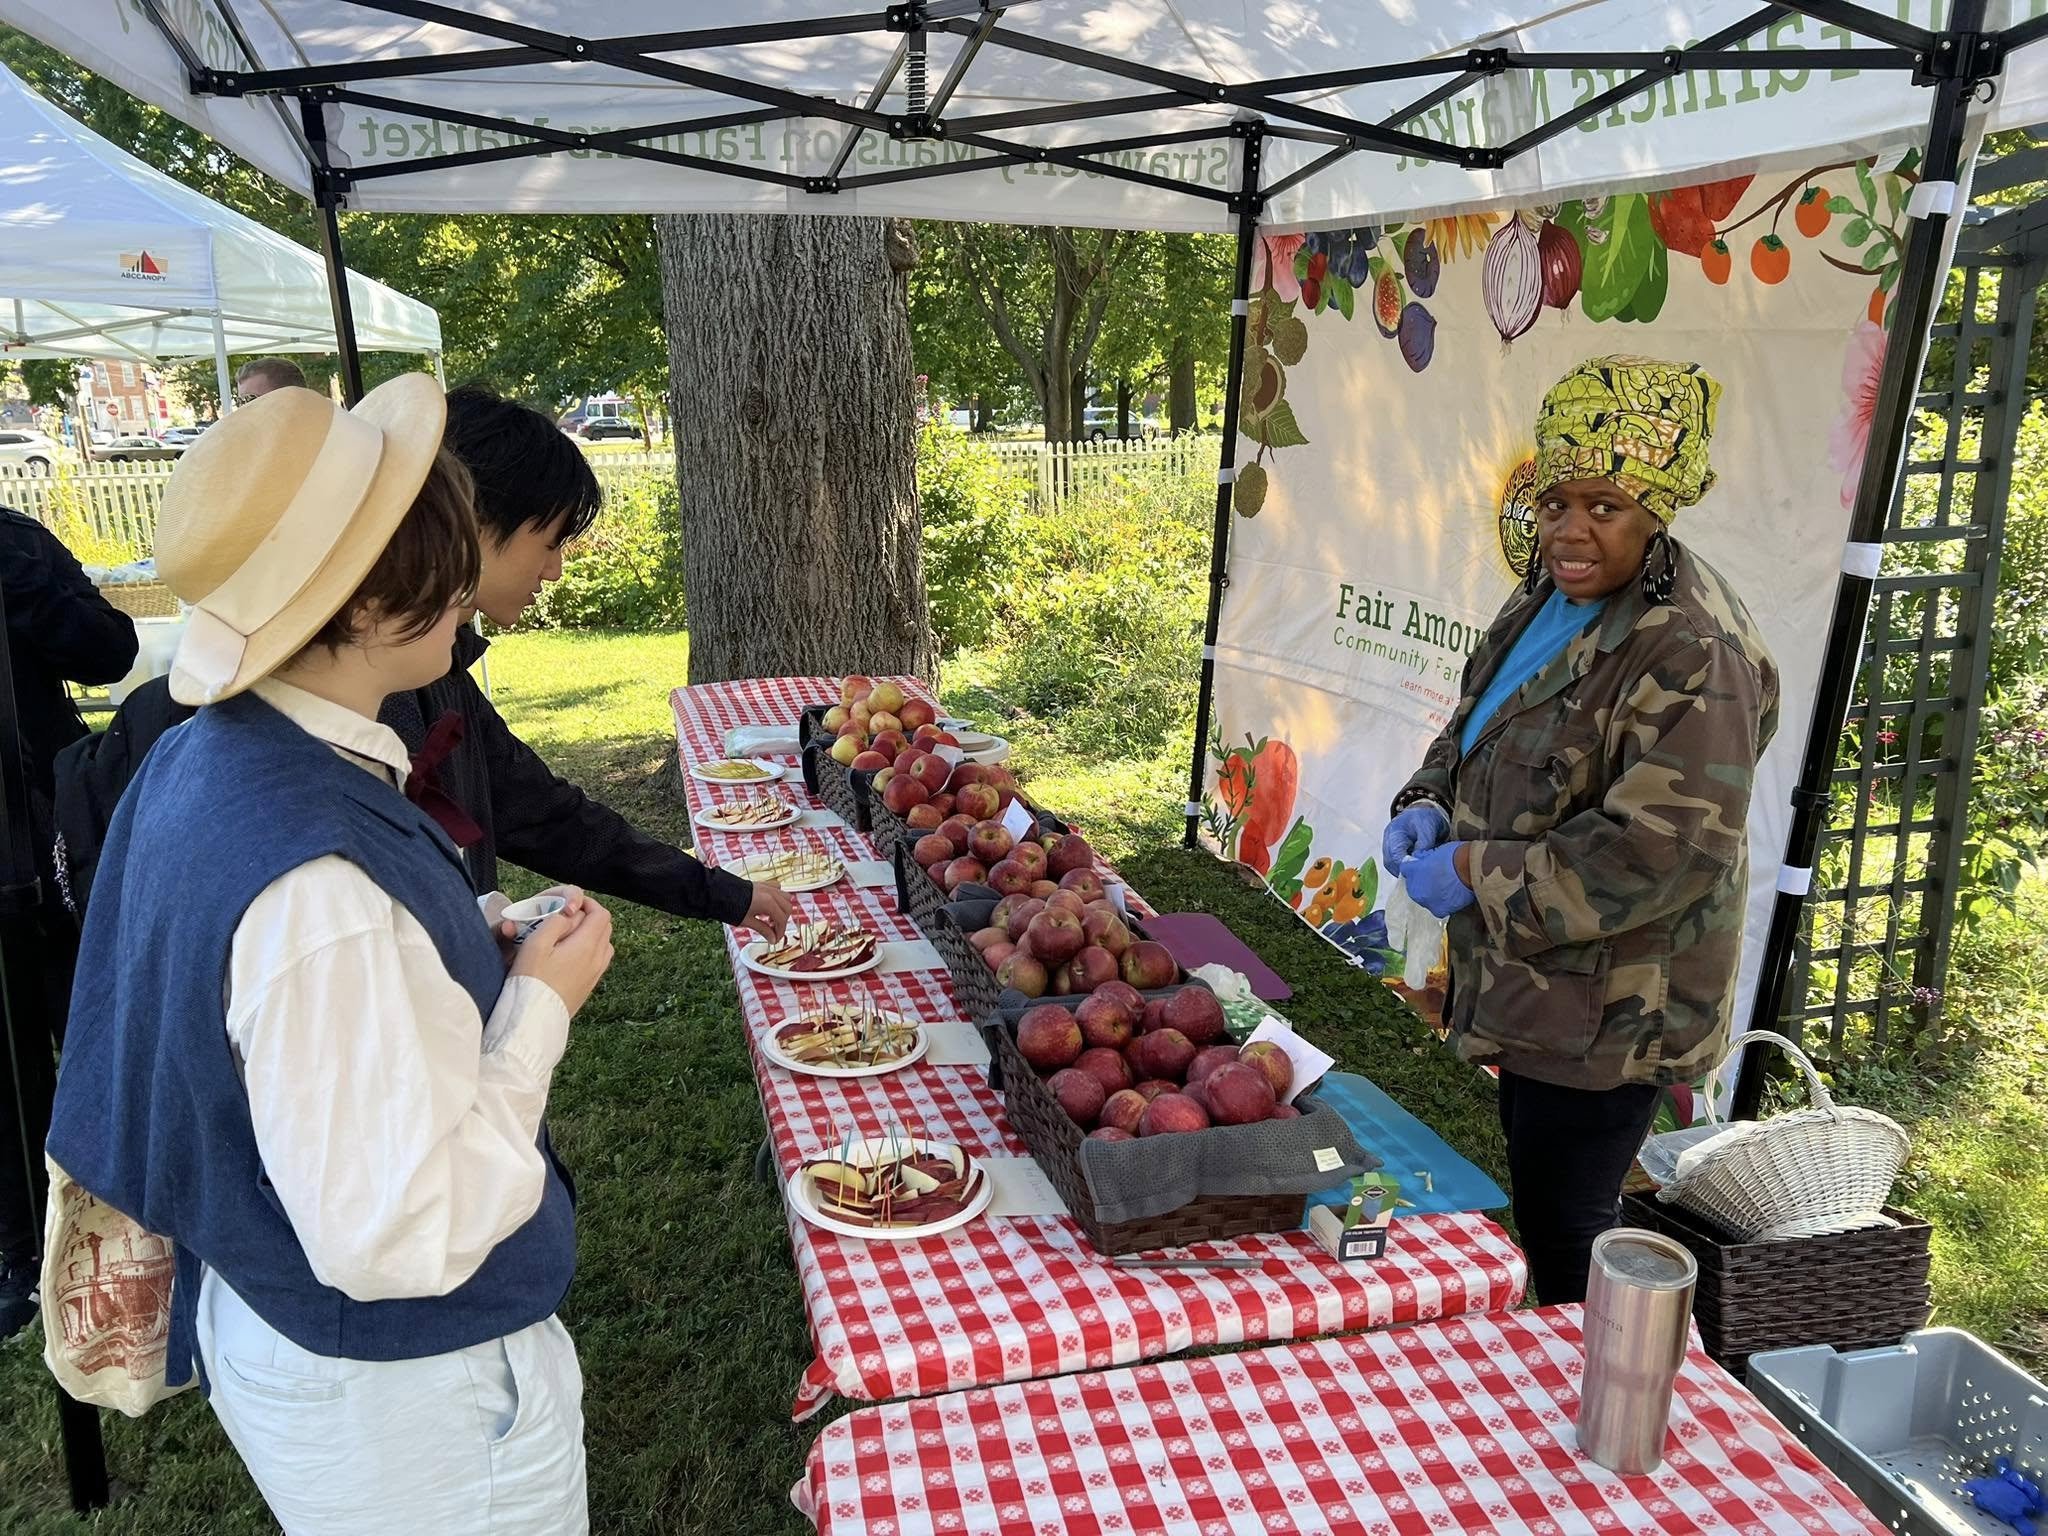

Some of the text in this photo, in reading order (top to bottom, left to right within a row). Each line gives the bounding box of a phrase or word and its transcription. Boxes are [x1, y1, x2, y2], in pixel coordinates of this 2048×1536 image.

[121, 272, 166, 281] ABCCANOPY
[1337, 584, 1486, 657] Fair Amou
[1333, 626, 1429, 676] Community
[1401, 676, 1423, 695] Learn
[1423, 686, 1443, 703] more
